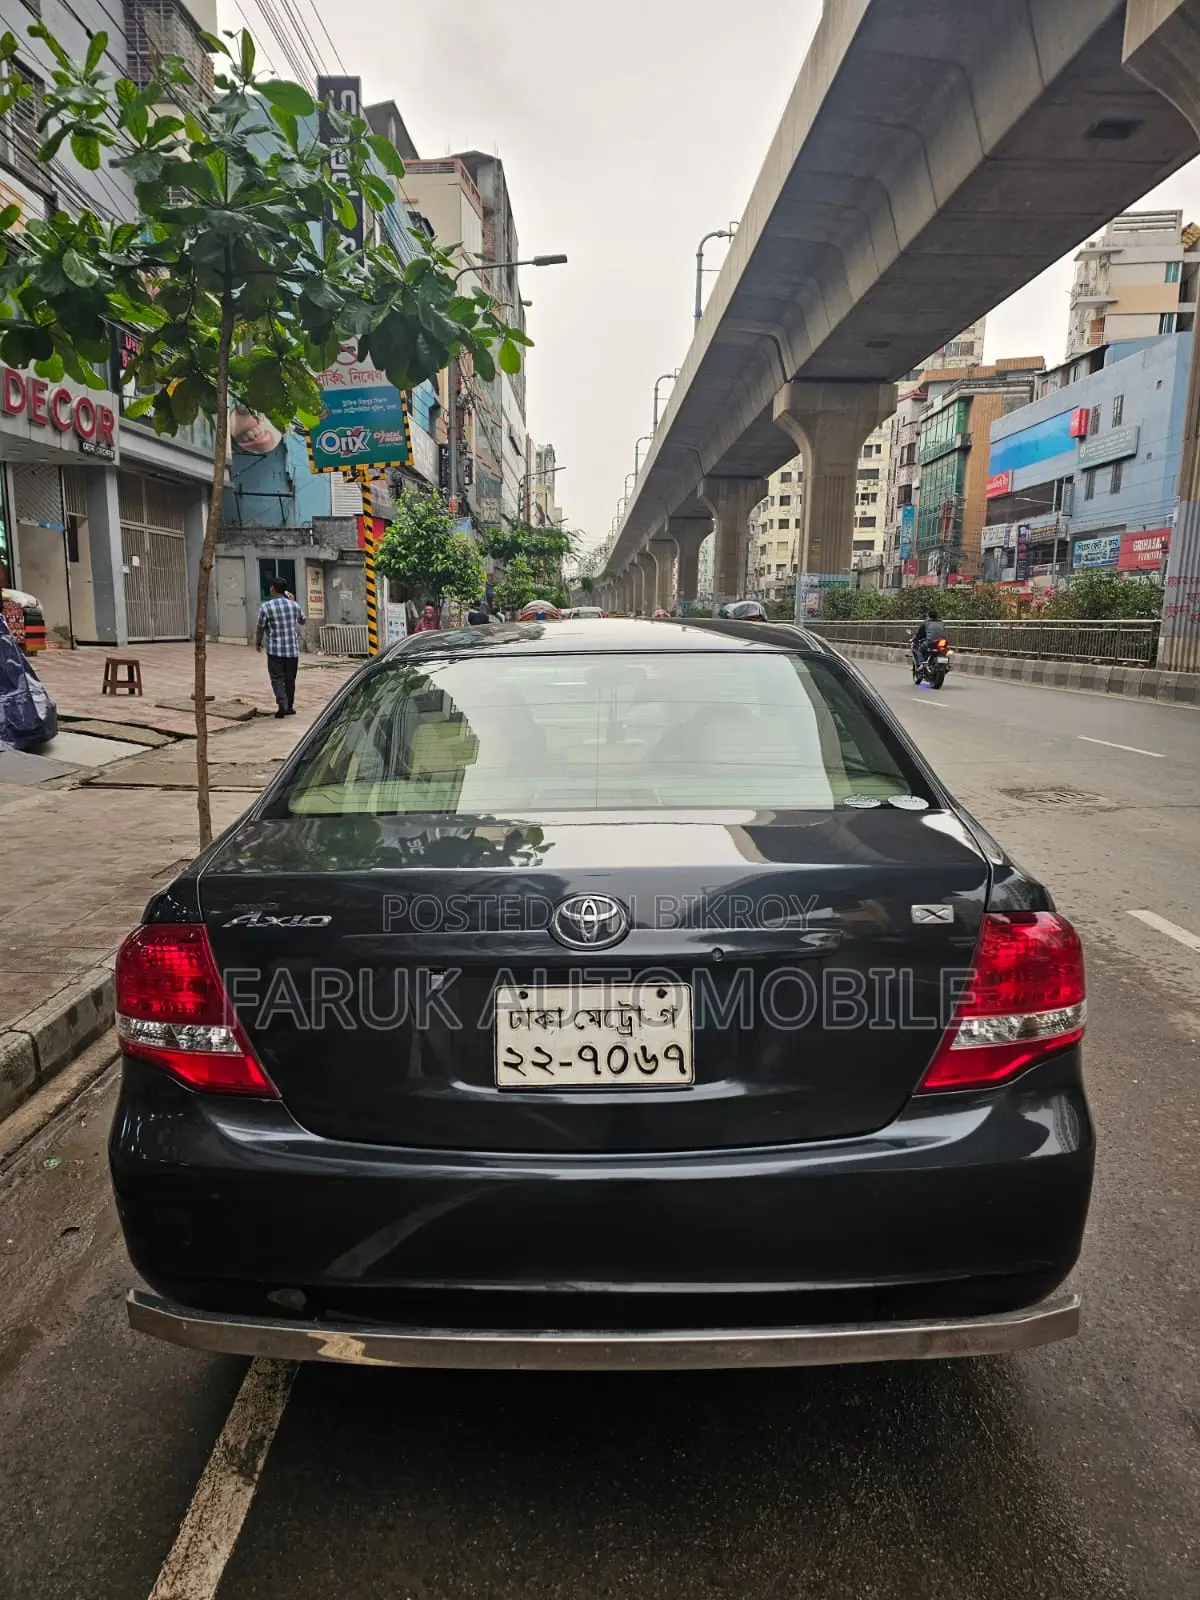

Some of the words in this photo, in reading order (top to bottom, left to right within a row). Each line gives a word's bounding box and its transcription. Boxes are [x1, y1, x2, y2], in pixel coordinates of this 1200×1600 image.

[4, 367, 115, 447] DECOR
[320, 429, 369, 453] Orix
[508, 1006, 565, 1030] ঢাকা
[503, 1043, 687, 1077] ২২-৭০৬৭
